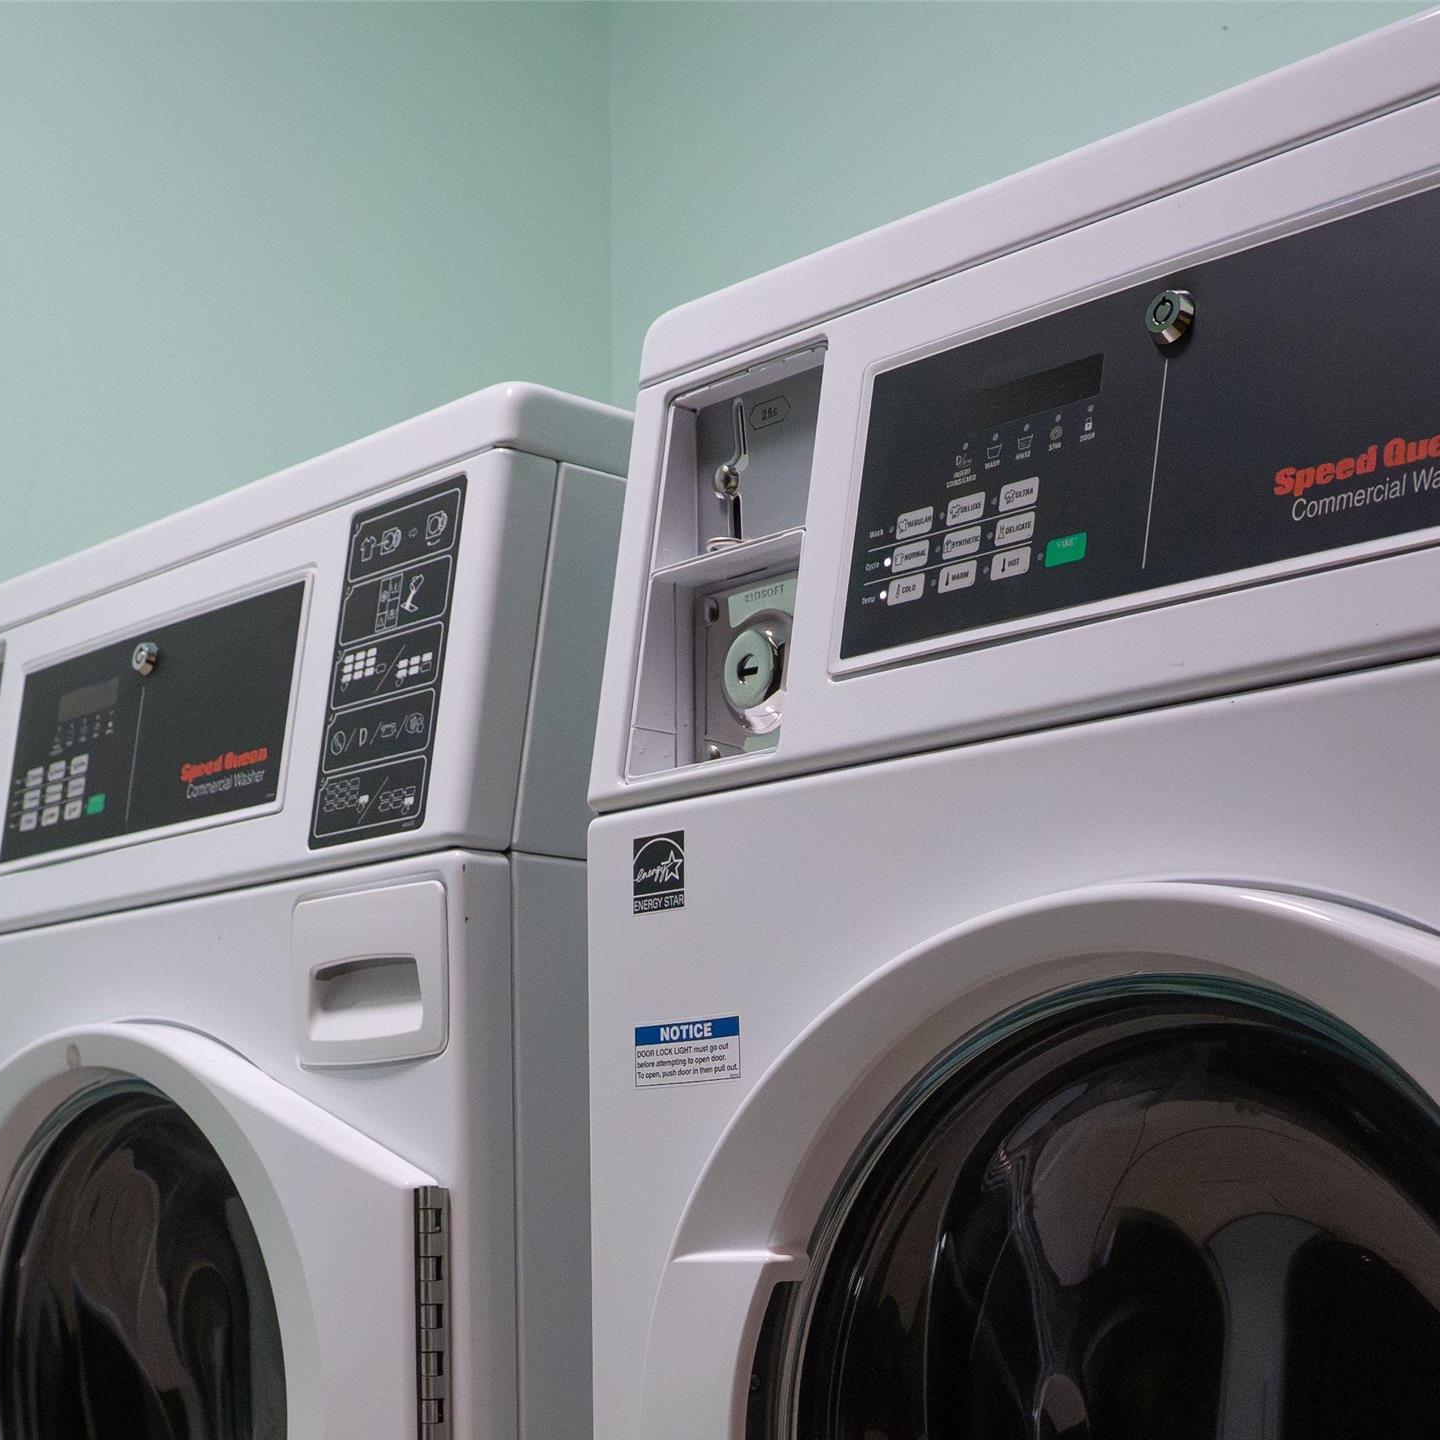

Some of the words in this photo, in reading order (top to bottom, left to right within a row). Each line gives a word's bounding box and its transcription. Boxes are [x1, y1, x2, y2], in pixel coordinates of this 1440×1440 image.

[1273, 444, 1378, 497] Speed
[1291, 474, 1407, 521] Commercial
[1005, 521, 1032, 535] DELICATE
[1007, 557, 1020, 568] HOT
[901, 584, 917, 594] COLD
[634, 897, 663, 912] ENERGY
[664, 894, 684, 907] STAR
[660, 1022, 712, 1041] NOTICE
[637, 1049, 654, 1058] DOOR
[656, 1048, 673, 1056] LOCK
[673, 1046, 692, 1055] LIGHT
[710, 1044, 717, 1053] go
[719, 1042, 729, 1050] out
[637, 1059, 655, 1069] before
[656, 1057, 686, 1067] attempting
[687, 1056, 693, 1064] to
[695, 1056, 710, 1065] open
[711, 1054, 726, 1062] door.
[637, 1071, 644, 1079] To
[662, 1069, 676, 1078] push
[678, 1067, 691, 1076] door
[692, 1066, 698, 1074] in
[700, 1065, 713, 1074] then
[714, 1064, 725, 1074] pull
